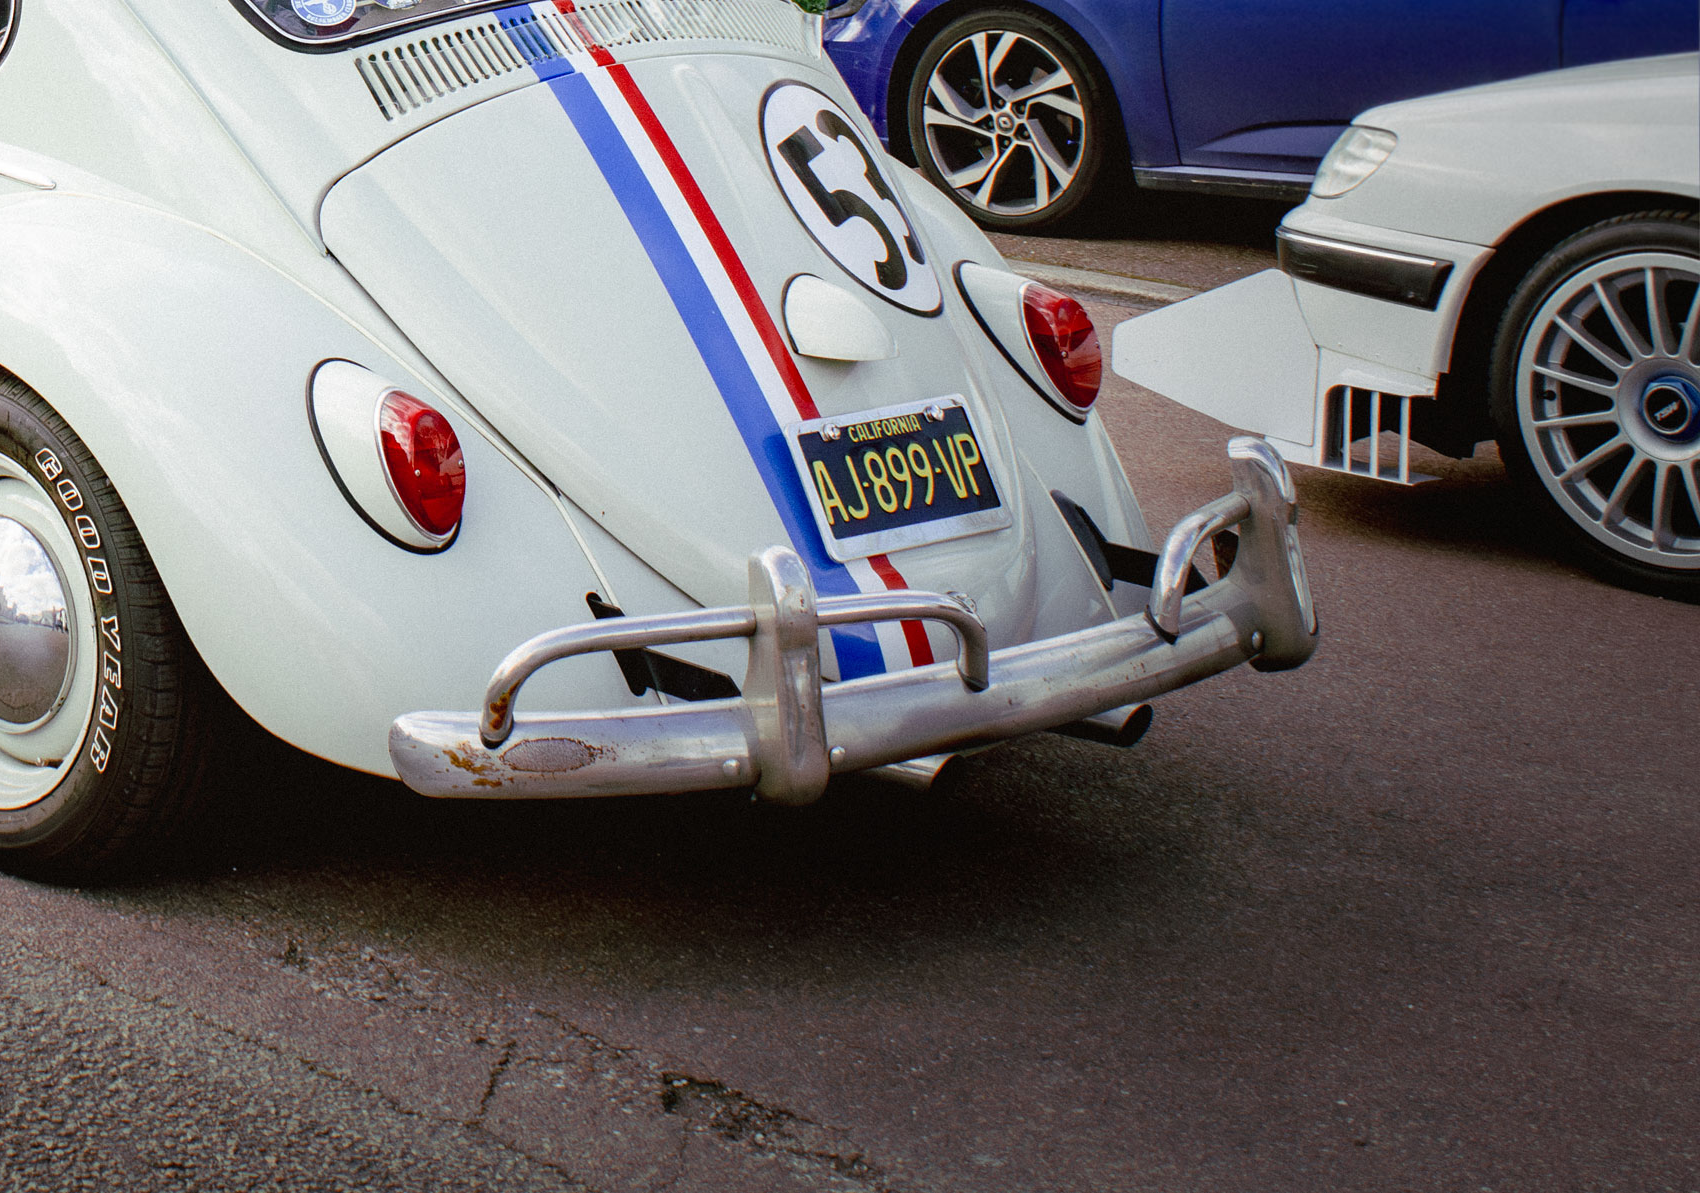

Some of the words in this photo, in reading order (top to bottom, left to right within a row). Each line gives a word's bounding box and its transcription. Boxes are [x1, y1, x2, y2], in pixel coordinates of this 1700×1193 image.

[776, 109, 926, 291] 53
[847, 414, 922, 443] CALIFORNIA
[34, 447, 113, 595] GOOD
[90, 616, 122, 773] YEAR
